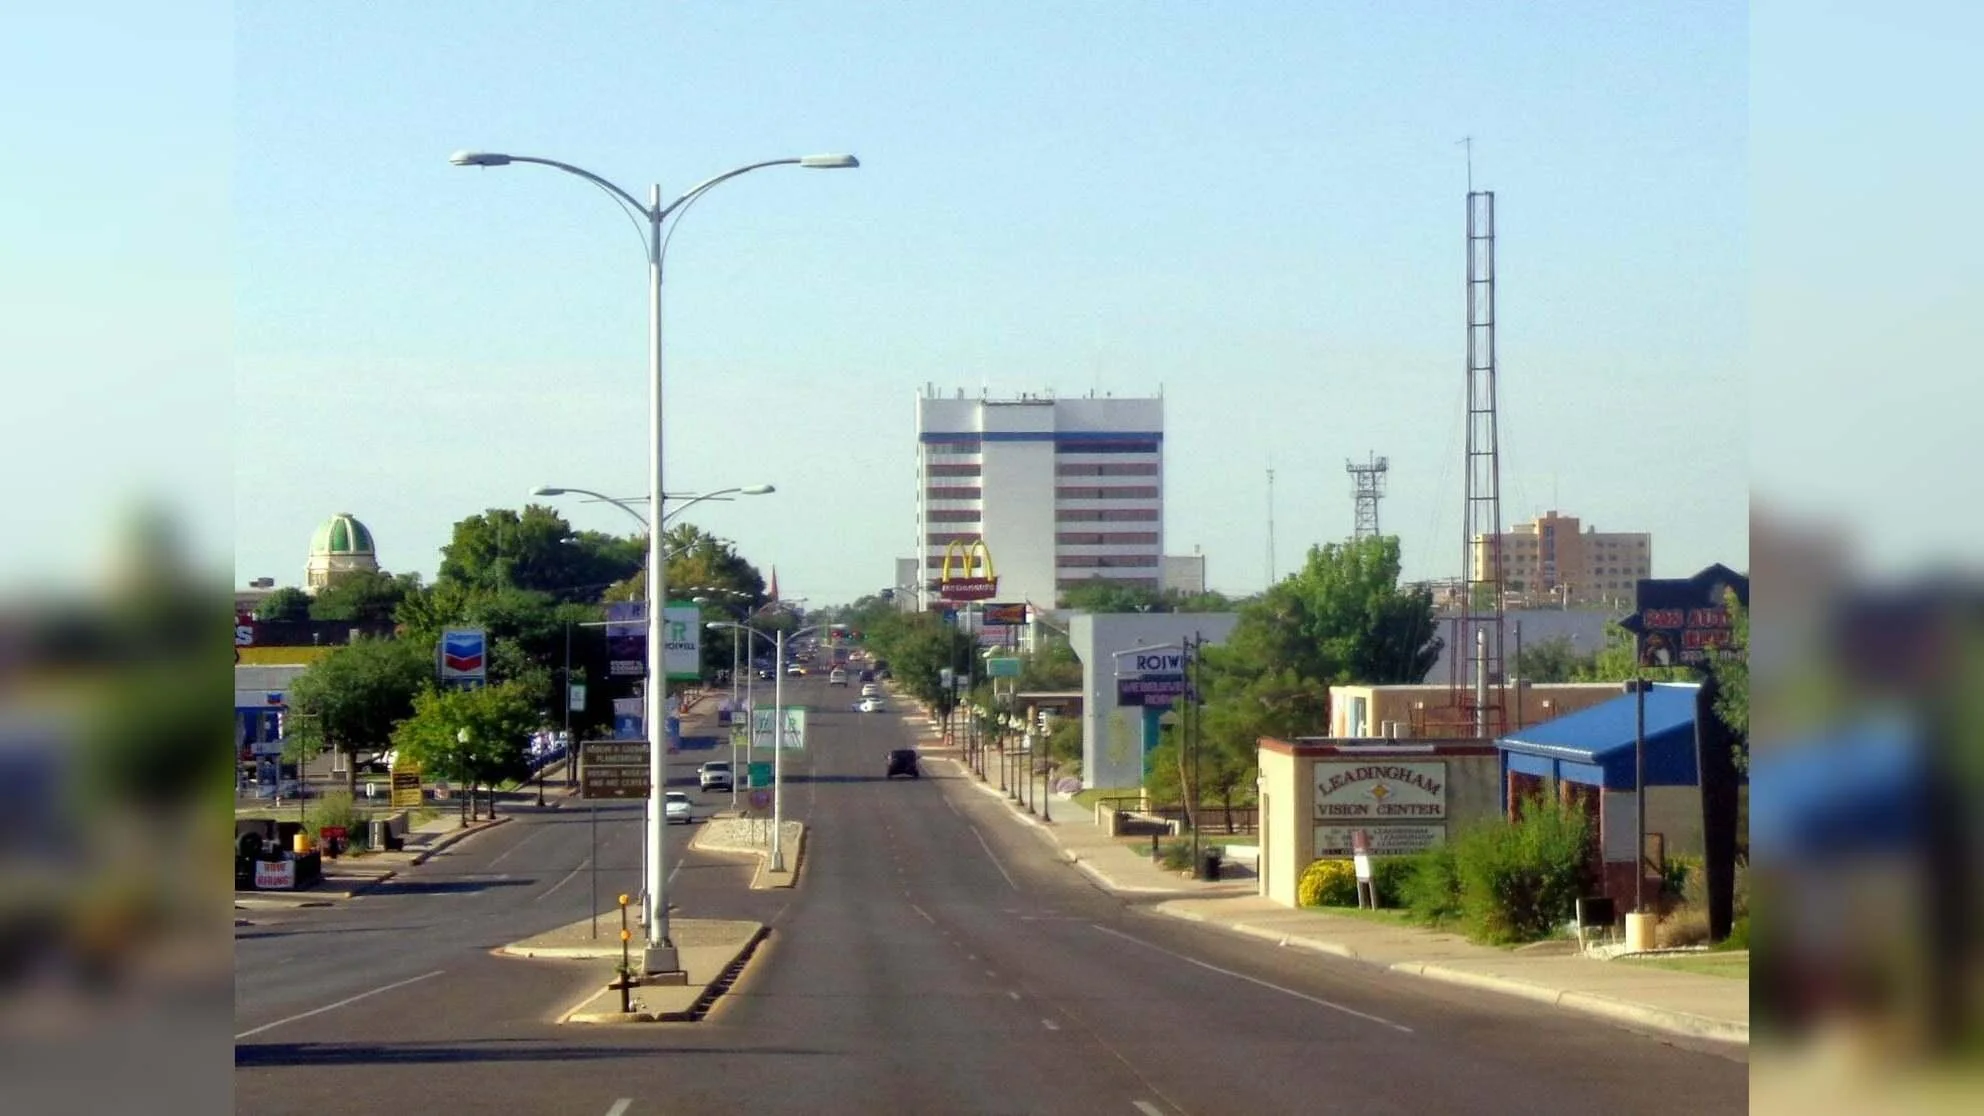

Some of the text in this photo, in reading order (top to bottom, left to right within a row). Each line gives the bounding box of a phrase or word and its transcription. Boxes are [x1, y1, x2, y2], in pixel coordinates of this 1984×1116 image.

[1319, 766, 1441, 796] LEADINGHAM
[1318, 804, 1441, 815] VISION CENTER
